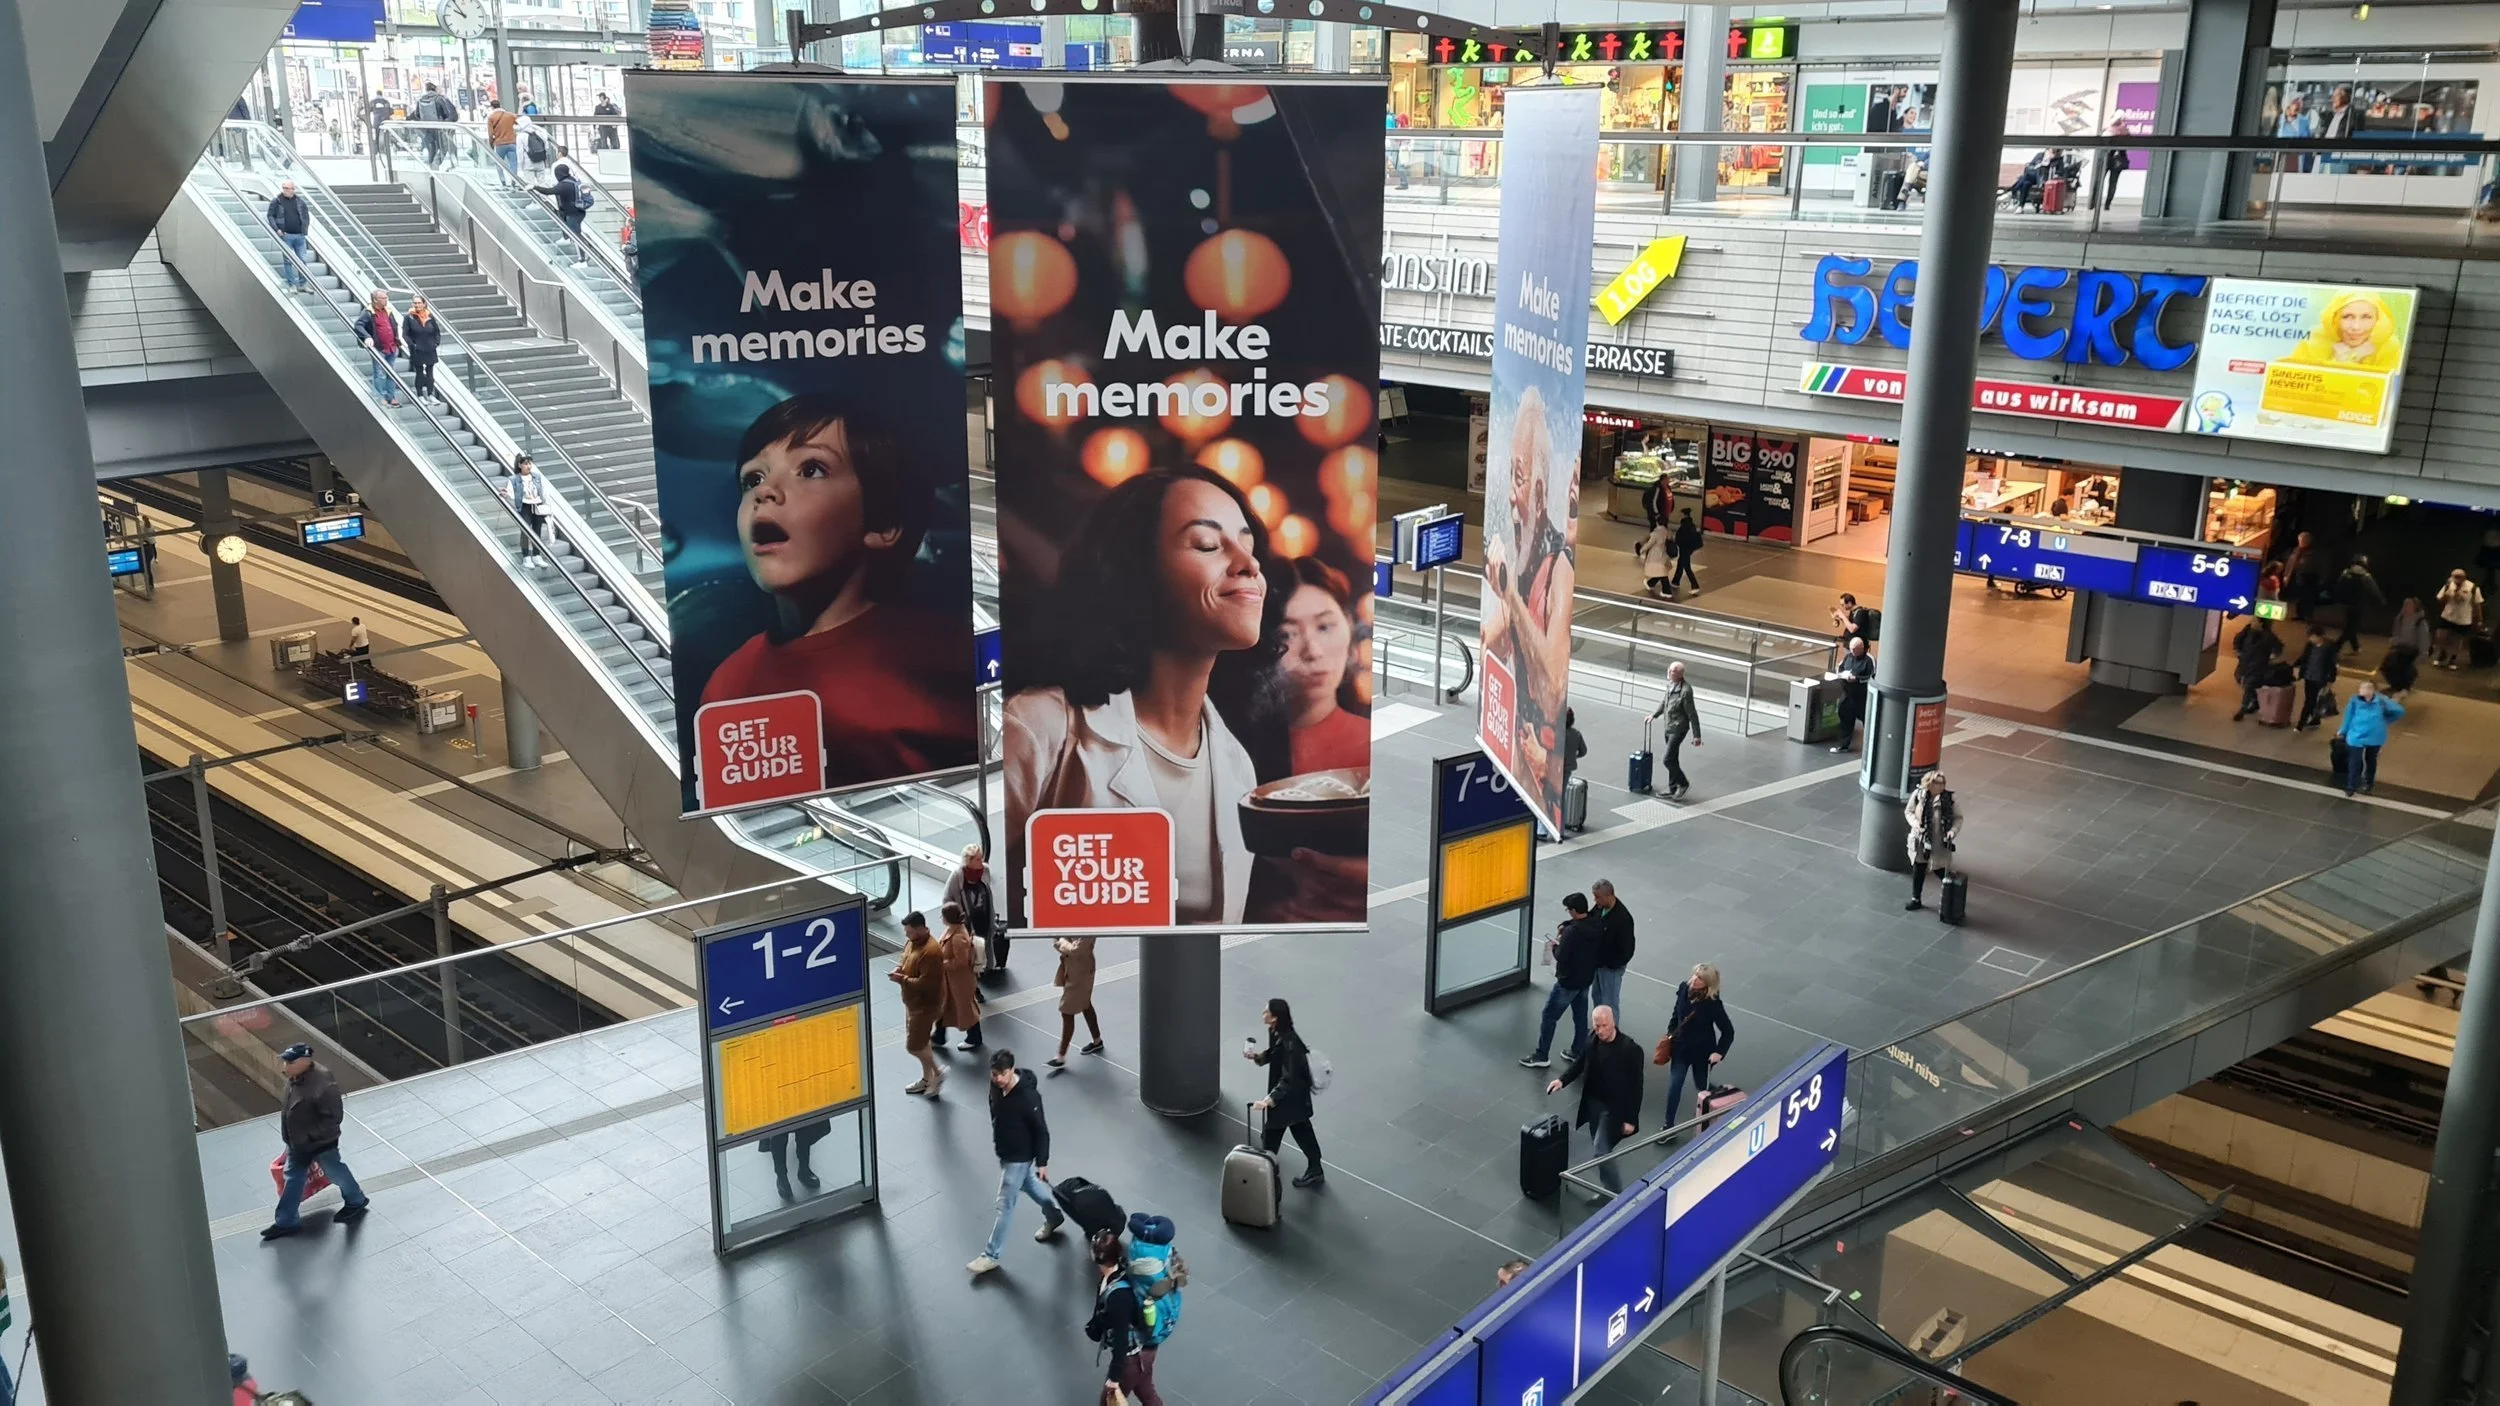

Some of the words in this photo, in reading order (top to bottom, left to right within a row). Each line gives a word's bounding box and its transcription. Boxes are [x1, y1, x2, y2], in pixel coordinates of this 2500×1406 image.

[1381, 252, 1437, 292] ans
[740, 268, 876, 313] Make
[1519, 270, 1560, 321] Make
[2215, 292, 2280, 307] BEFREIT
[2282, 296, 2308, 309] DIE
[2212, 309, 2257, 323] NASE,
[2262, 309, 2302, 323] LÖST
[692, 314, 926, 363] memories
[1103, 309, 1271, 360] Make
[2209, 323, 2241, 336] DEN
[2244, 325, 2312, 341] SCHLEIM
[1504, 321, 1574, 376] memories
[1584, 344, 1667, 375] ERRASSE
[1045, 367, 1330, 417] memories
[1863, 376, 1903, 396] von
[1980, 388, 2022, 409] aus
[2029, 391, 2138, 421] wirksam
[1712, 439, 1752, 463] BIG
[1758, 448, 1795, 470] 9,90
[324, 490, 334, 504] 6
[107, 513, 121, 533] 5-6
[1999, 526, 2032, 548] 7-8
[2055, 535, 2066, 550] U
[2191, 554, 2231, 577] 5-6
[345, 682, 360, 701] E
[1489, 673, 1503, 701] GET
[1488, 690, 1509, 730] YOUR
[718, 717, 770, 744] GET
[1487, 711, 1509, 752] GUIDE
[720, 735, 798, 764] YOUR
[721, 754, 803, 785] GUIDE
[1456, 761, 1509, 803] 7-8
[1053, 833, 1113, 857] GET
[1054, 858, 1145, 881] YOUR
[1054, 881, 1150, 905] GUIDE
[752, 918, 837, 980] 1-2
[1751, 1121, 1765, 1153] U
[1786, 1074, 1823, 1129] 5-8
